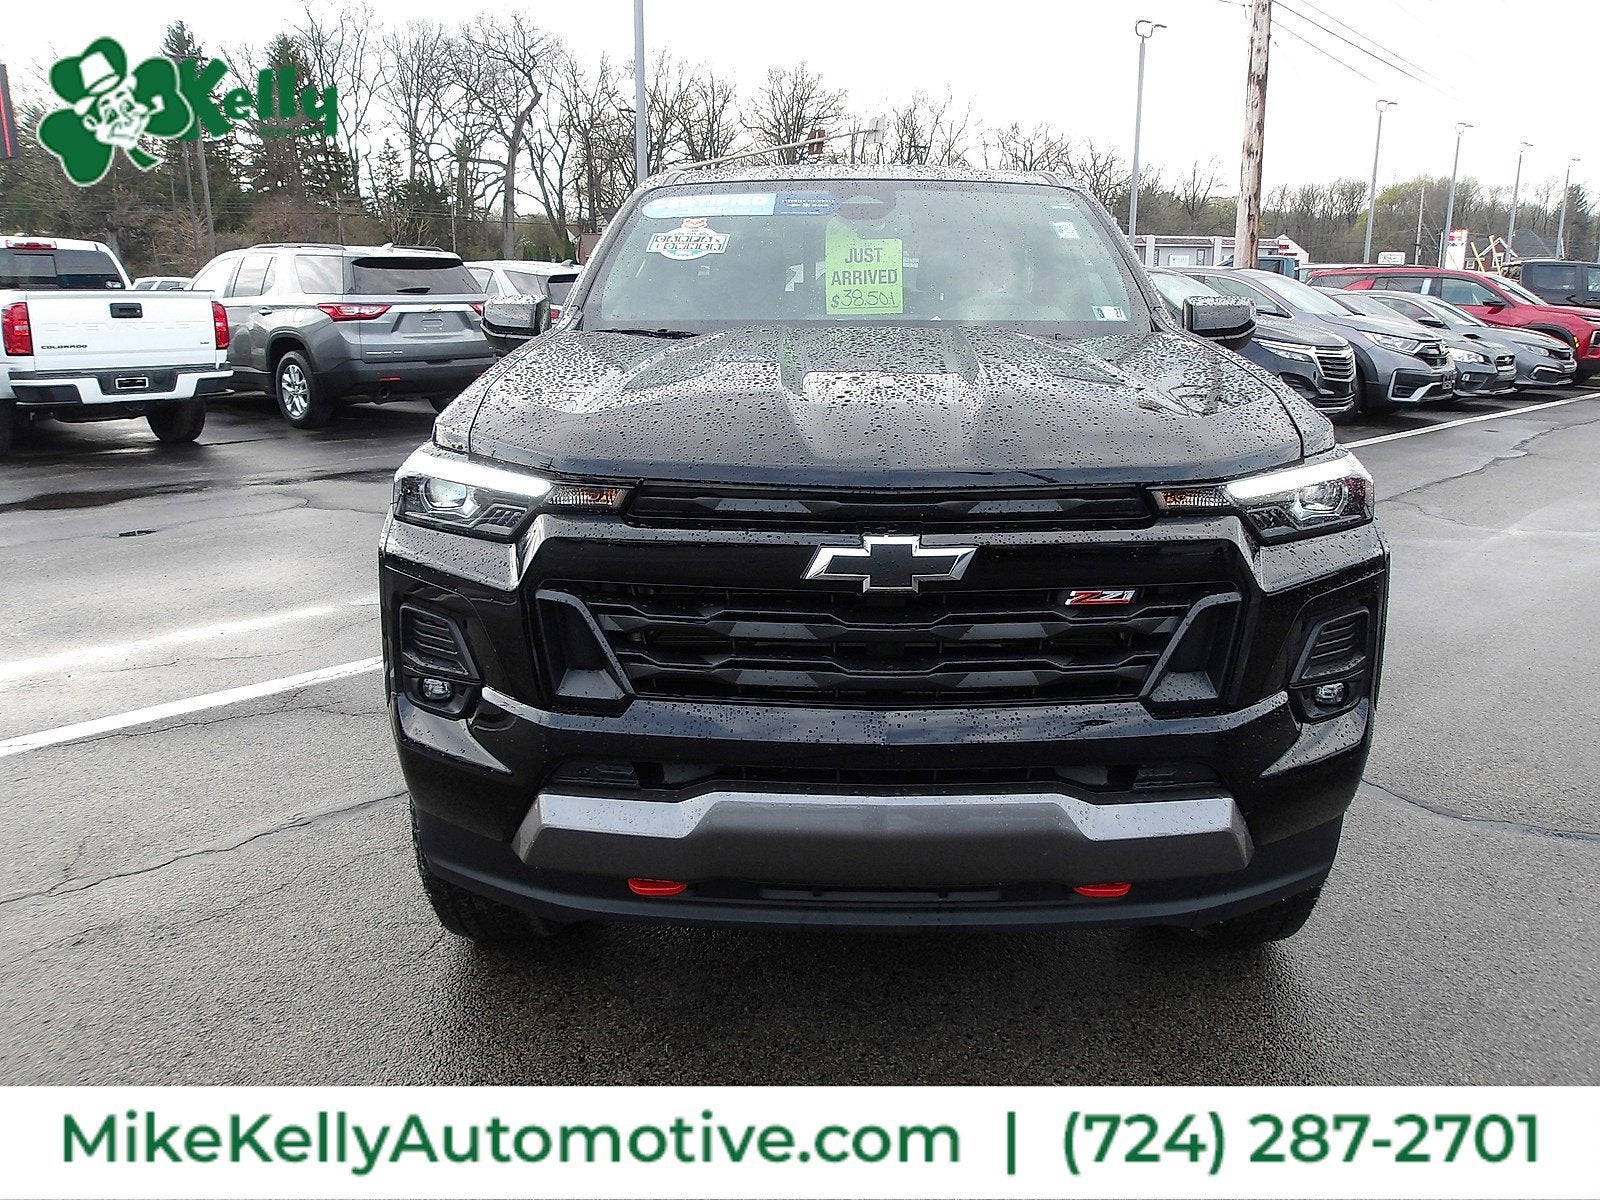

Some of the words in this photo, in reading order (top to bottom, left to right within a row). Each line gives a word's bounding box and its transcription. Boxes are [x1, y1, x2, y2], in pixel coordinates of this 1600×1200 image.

[845, 247, 883, 264] JUST
[831, 269, 898, 286] ARRIVED
[1065, 590, 1135, 605] Z71
